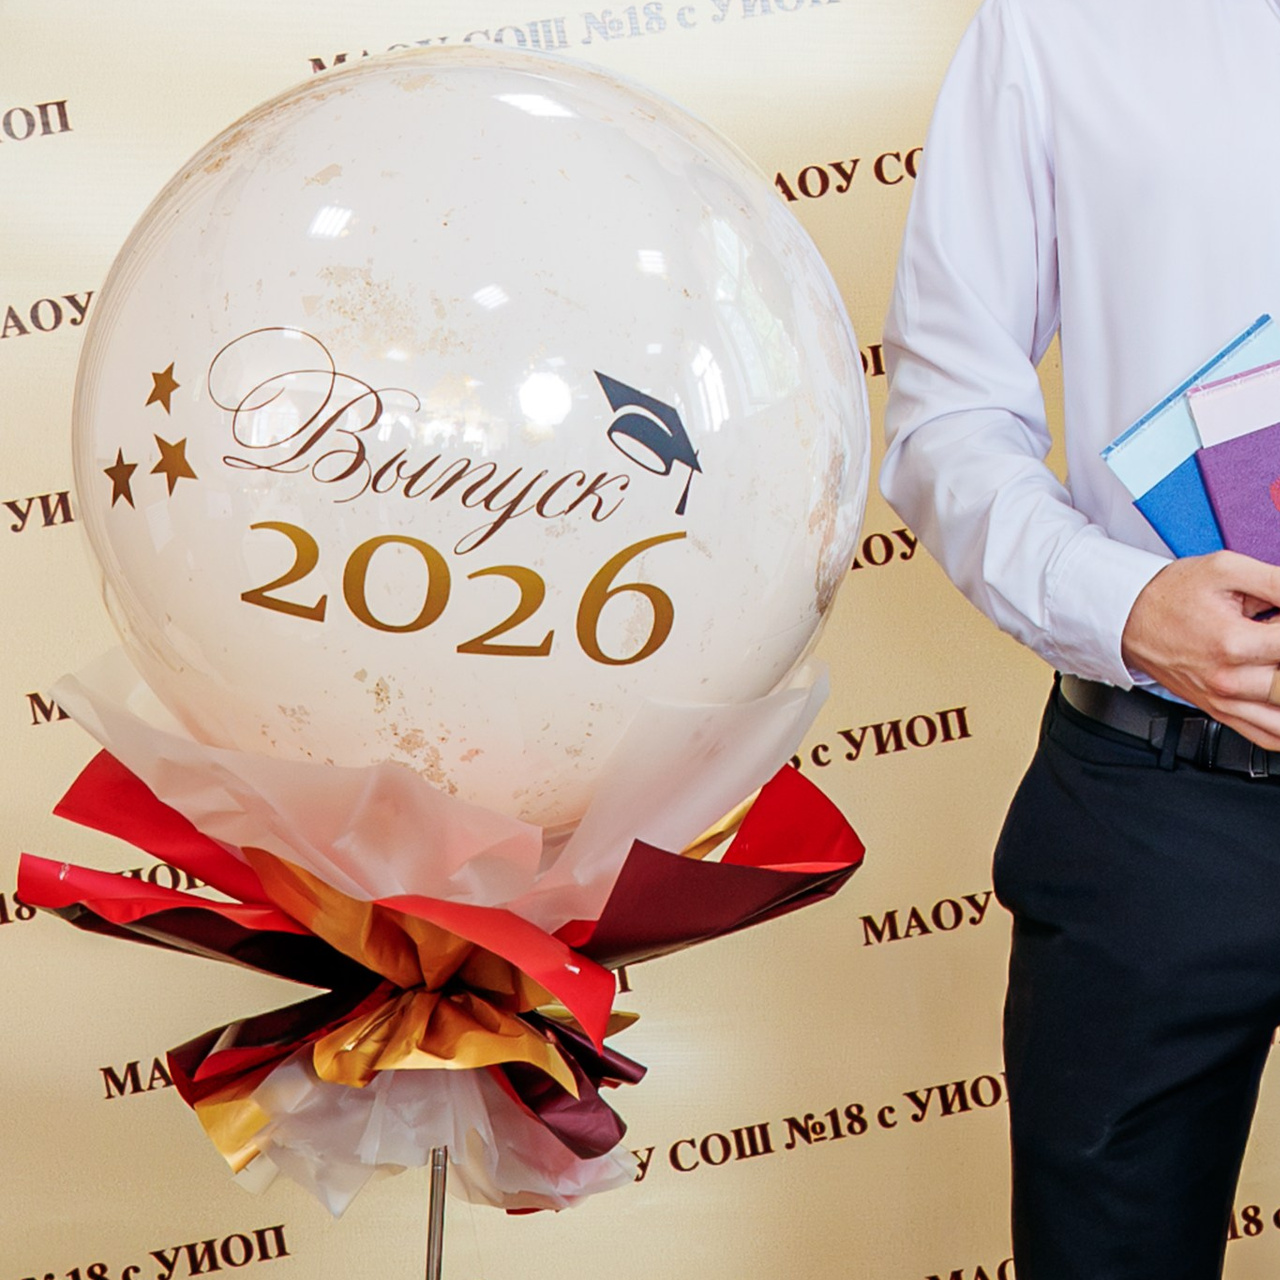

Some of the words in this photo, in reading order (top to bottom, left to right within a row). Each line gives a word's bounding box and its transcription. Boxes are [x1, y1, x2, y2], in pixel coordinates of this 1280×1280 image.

[579, 1, 667, 46] №18
[675, 5, 698, 30] с
[2, 100, 72, 141] ОП
[774, 158, 861, 202] АОУ
[0, 290, 94, 339] АОУ
[208, 326, 630, 555] Выпуск
[2, 490, 75, 533] УИ
[852, 528, 918, 571] ОУ
[241, 520, 687, 666] 2026
[809, 742, 833, 768] с
[837, 706, 972, 762] УИОП
[0, 891, 37, 924] 18
[859, 890, 993, 947] МАОУ
[99, 1057, 175, 1100] МА
[668, 1121, 775, 1172] СОШ
[782, 1103, 868, 1150] №18
[876, 1104, 899, 1130] с
[903, 1071, 1008, 1122] УИО
[1227, 1204, 1264, 1241] 18
